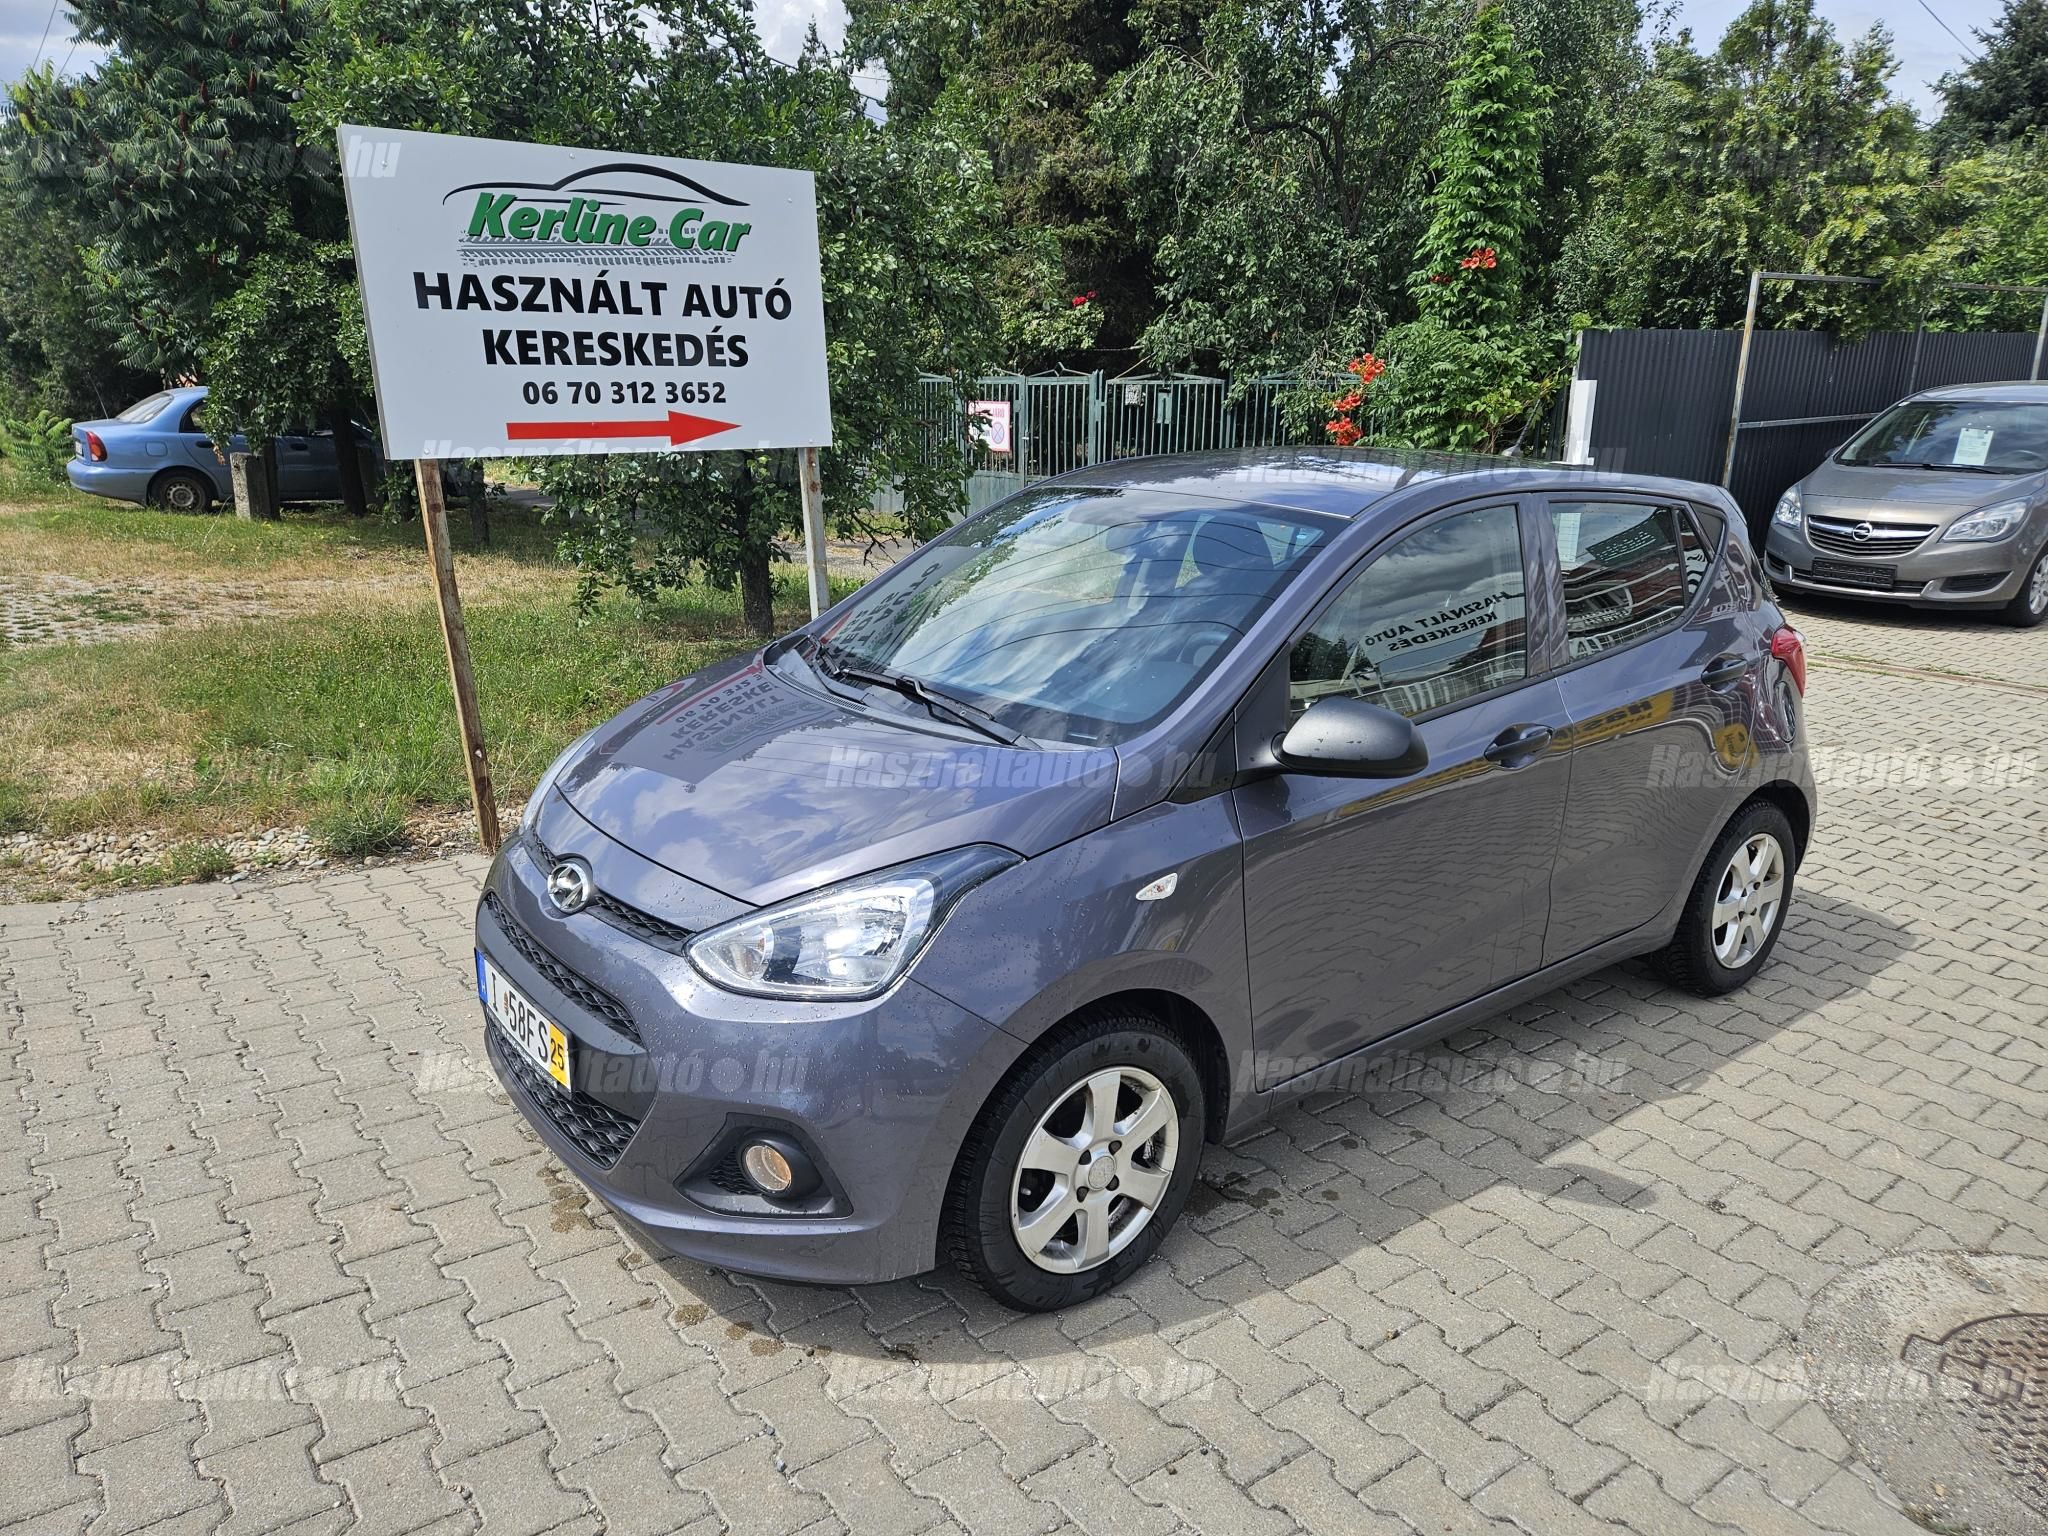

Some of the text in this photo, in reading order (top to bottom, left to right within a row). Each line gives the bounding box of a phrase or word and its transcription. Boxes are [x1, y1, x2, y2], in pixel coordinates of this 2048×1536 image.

[467, 192, 751, 252] Kerline Car
[413, 270, 792, 320] HASZNÁLT AUTÓ
[482, 326, 749, 368] KERESKEDÉS
[522, 381, 726, 405] 06 70 312 3652
